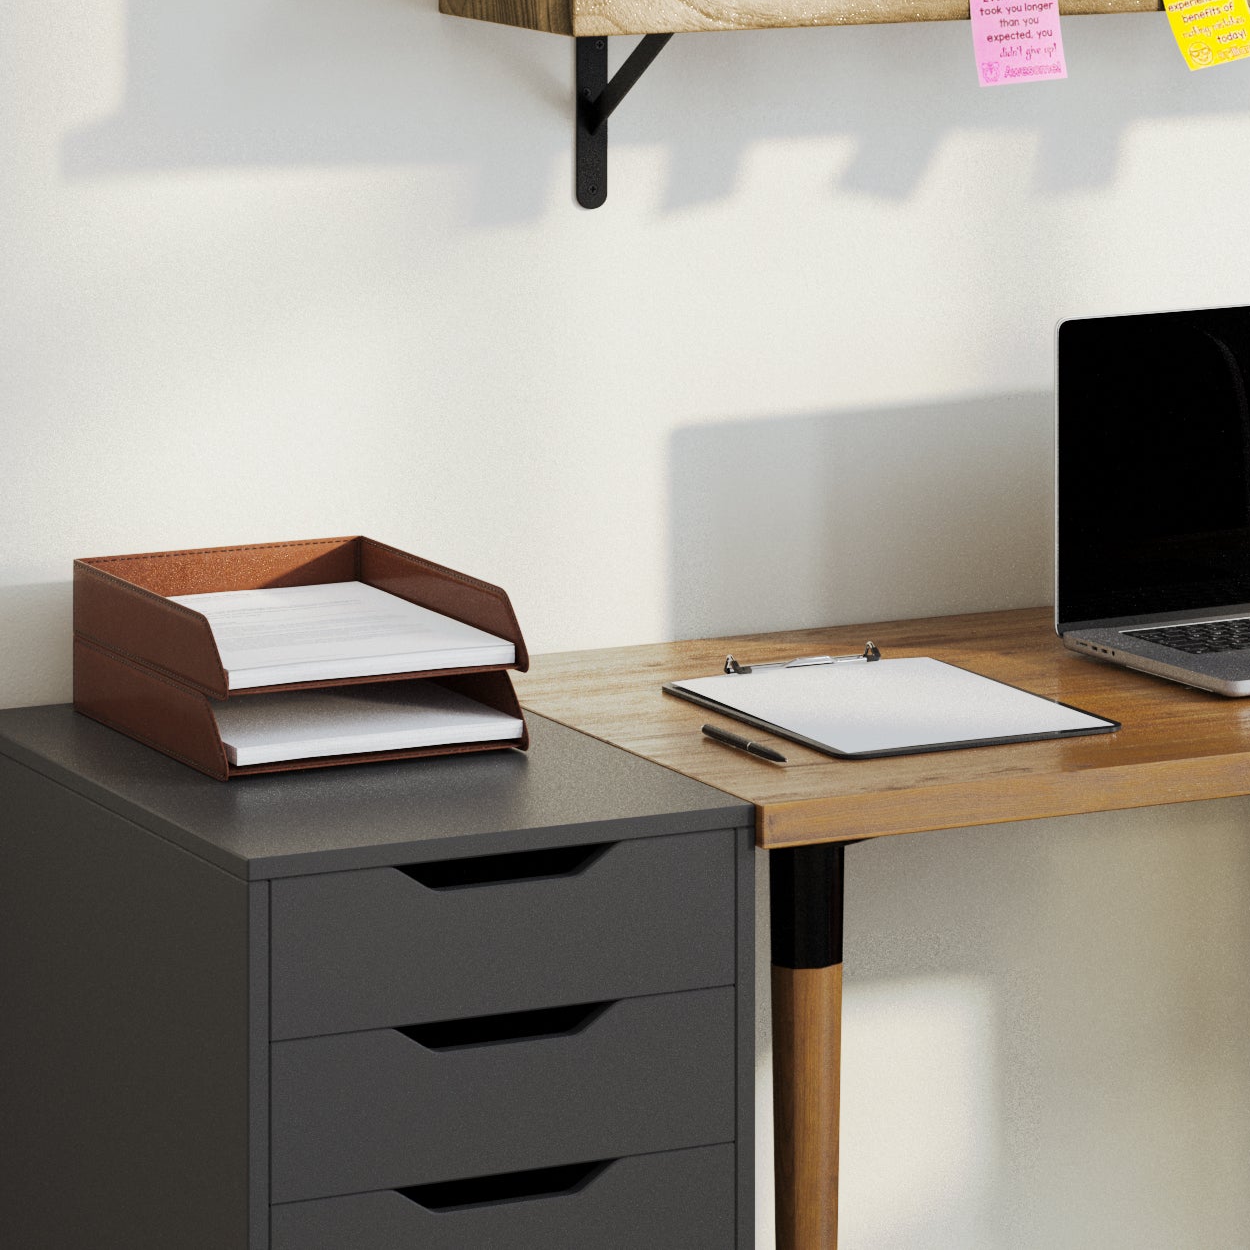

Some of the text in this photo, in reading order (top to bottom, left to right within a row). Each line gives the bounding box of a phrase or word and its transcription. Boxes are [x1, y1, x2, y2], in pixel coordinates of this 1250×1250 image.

[980, 2, 1053, 16] took you longer
[1182, 2, 1233, 23] benefits of
[1000, 18, 1039, 28] than you
[1036, 29, 1052, 39] you
[1217, 29, 1246, 44] today!
